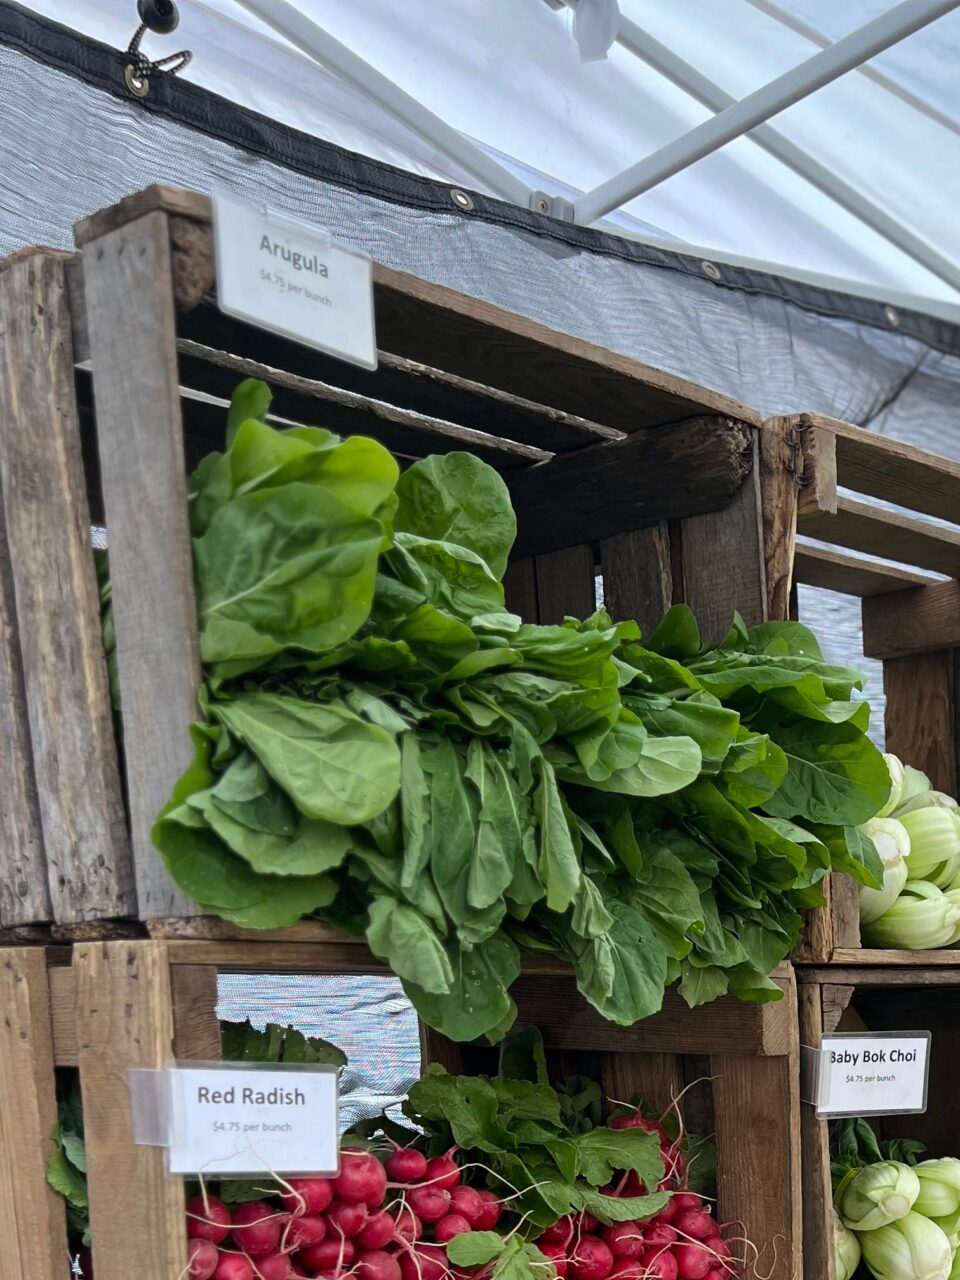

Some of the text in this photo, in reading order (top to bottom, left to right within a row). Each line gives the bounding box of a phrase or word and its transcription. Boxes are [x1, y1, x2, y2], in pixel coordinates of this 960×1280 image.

[259, 234, 329, 278] Arugula
[259, 269, 332, 307] $4.75 per bunch
[830, 1049, 917, 1066] Baby Bok Choi
[846, 1074, 896, 1084] $4.75 per bunch
[198, 1086, 306, 1105] Red Radish
[212, 1121, 292, 1134] $4.75 per bunch
